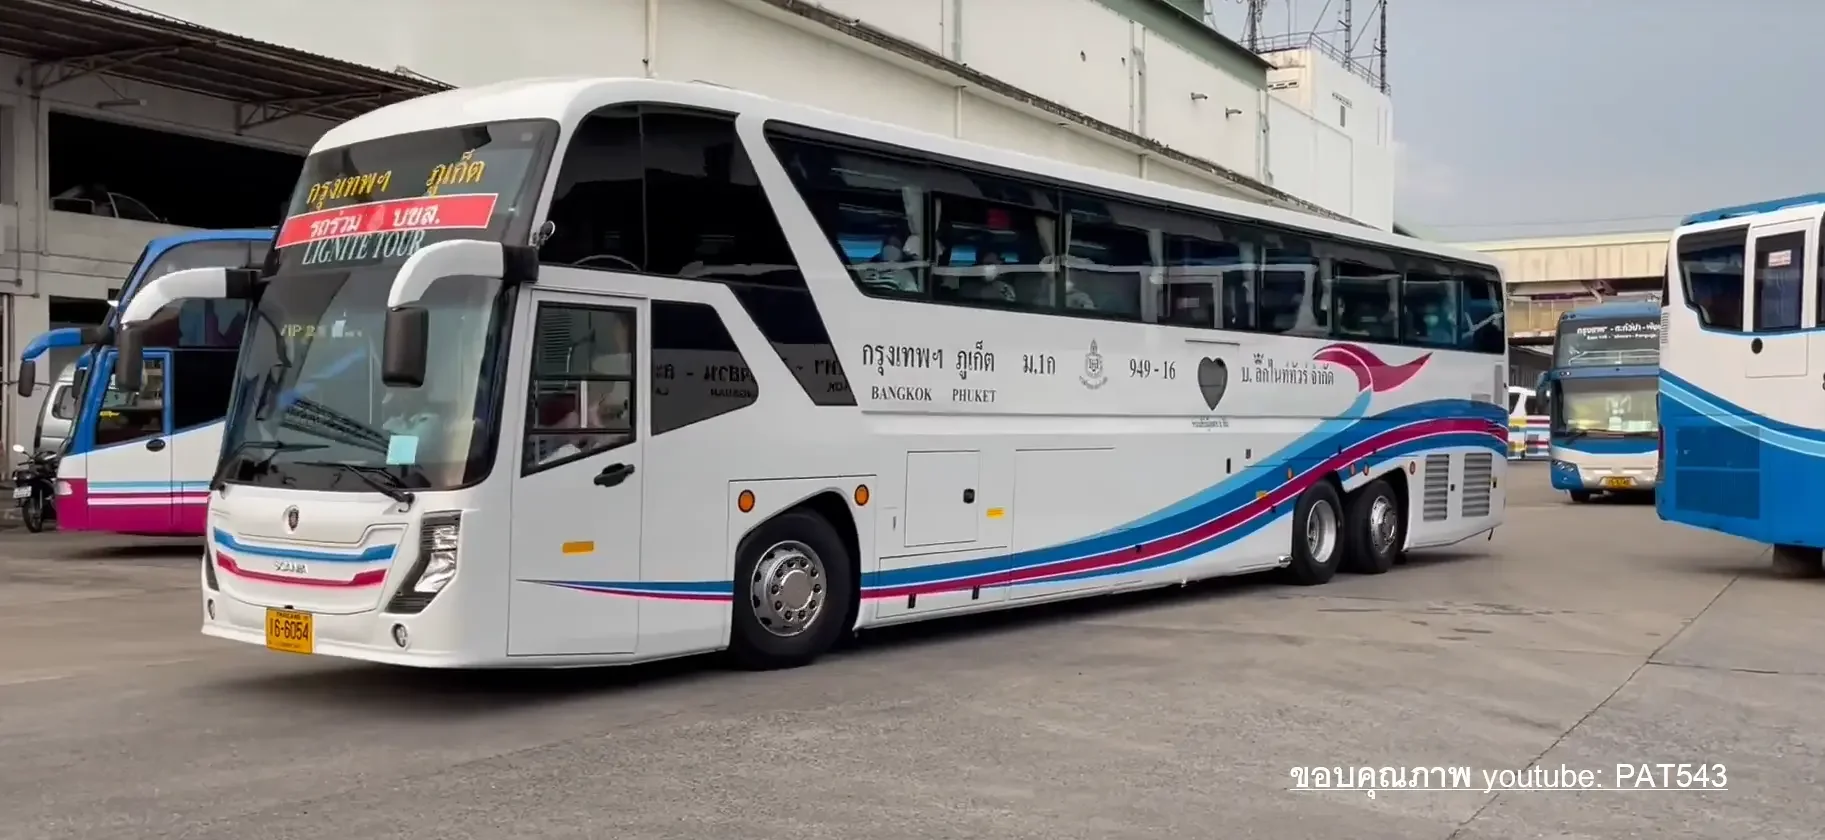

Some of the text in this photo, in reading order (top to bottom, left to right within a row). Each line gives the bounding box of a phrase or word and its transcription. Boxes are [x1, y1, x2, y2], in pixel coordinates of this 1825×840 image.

[306, 149, 486, 210] กรุงเทพฯ ภูเก็ต
[310, 204, 440, 238] รถร่วม บขส.
[302, 229, 426, 265] LIGNITE TOUR
[862, 343, 944, 376] กรุงเทพฯ
[955, 340, 995, 380] ภูเก็ต
[1022, 353, 1056, 375] ม.1ก
[1129, 358, 1151, 378] 949
[1163, 360, 1176, 380] 16
[871, 386, 997, 403] BANGKOK PHUKET
[269, 618, 309, 641] 16-6054
